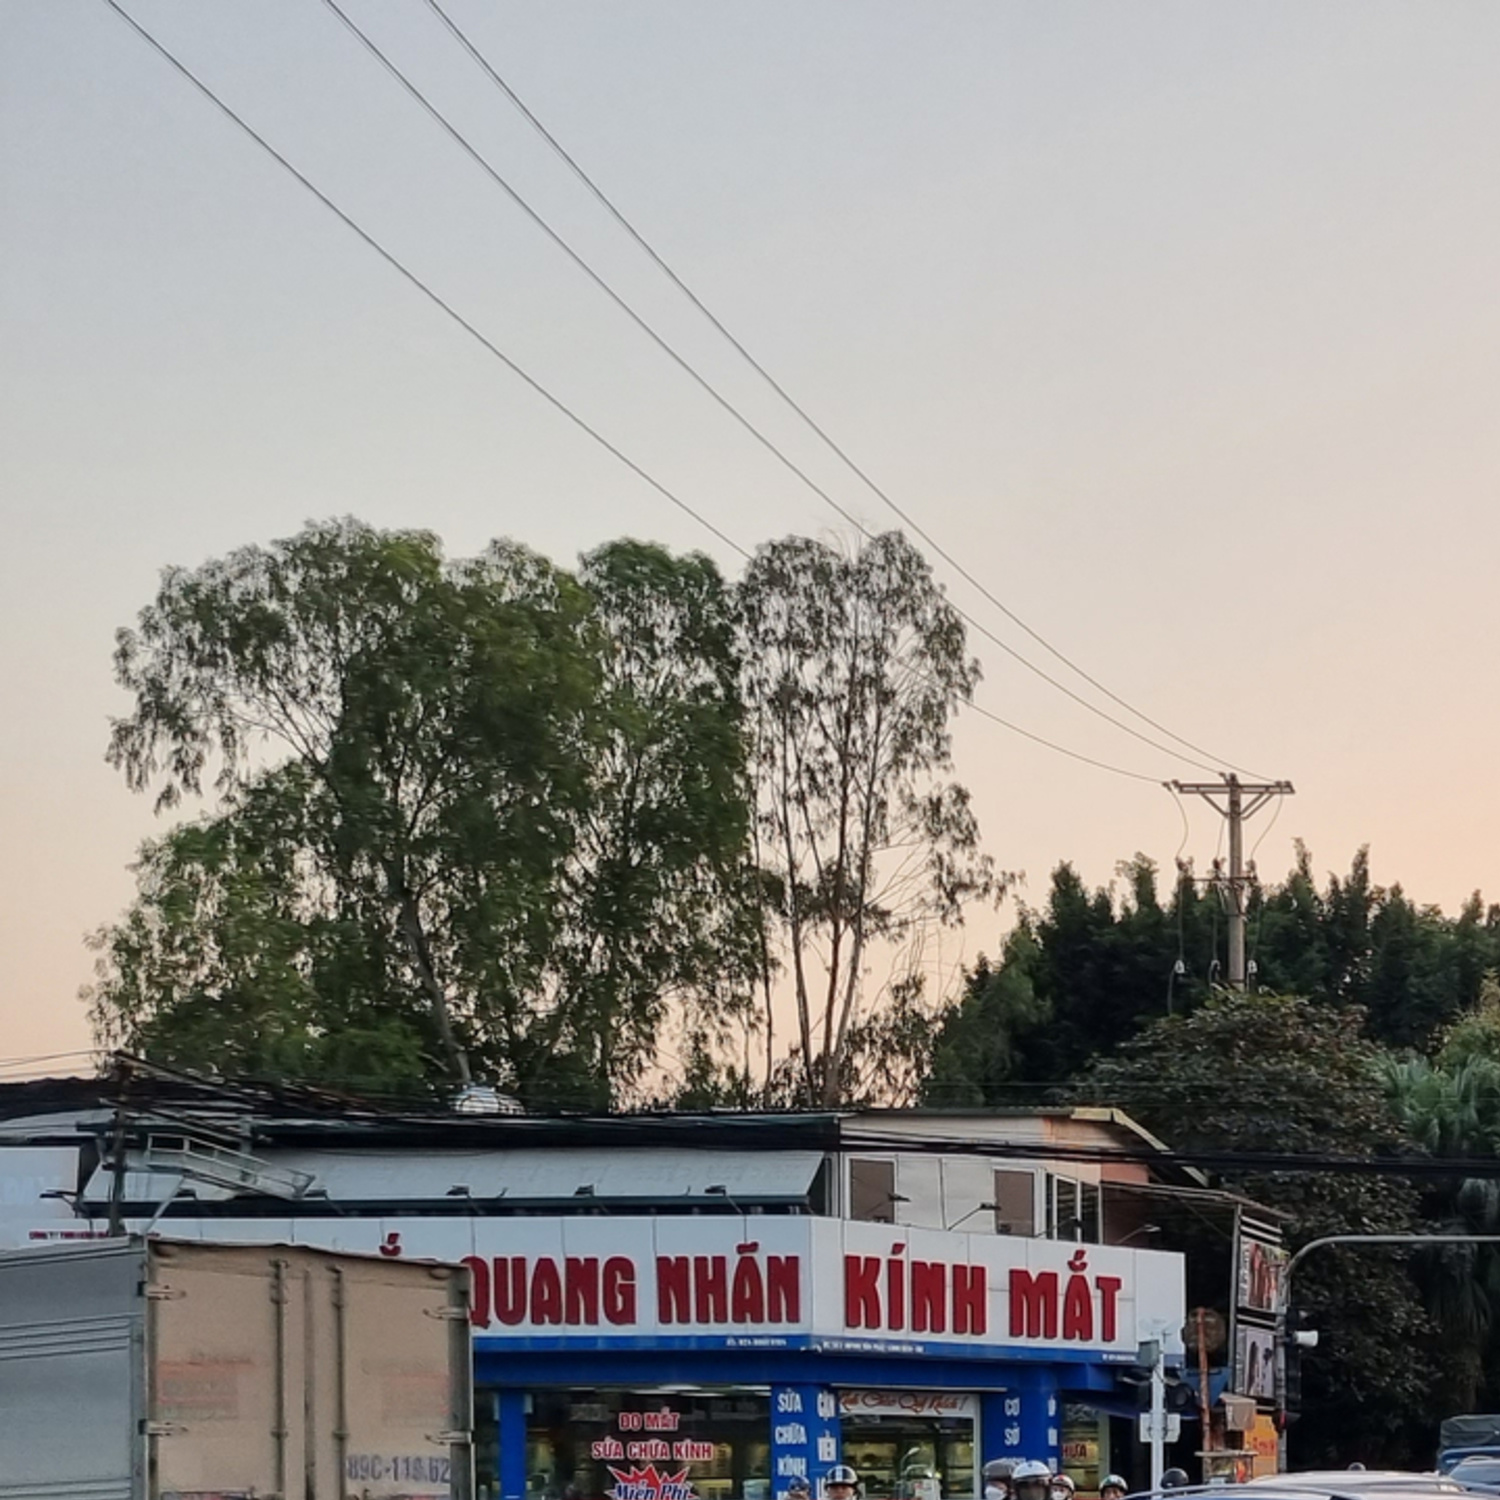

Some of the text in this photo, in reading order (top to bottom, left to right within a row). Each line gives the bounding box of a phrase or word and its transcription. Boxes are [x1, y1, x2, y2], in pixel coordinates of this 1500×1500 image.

[467, 1242, 801, 1329] QUANG NHÃN
[844, 1244, 1122, 1342] KÍNH MẮT
[619, 1405, 680, 1430] ĐO MẮT
[592, 1435, 713, 1460] SỬA CHỮA KÍNH
